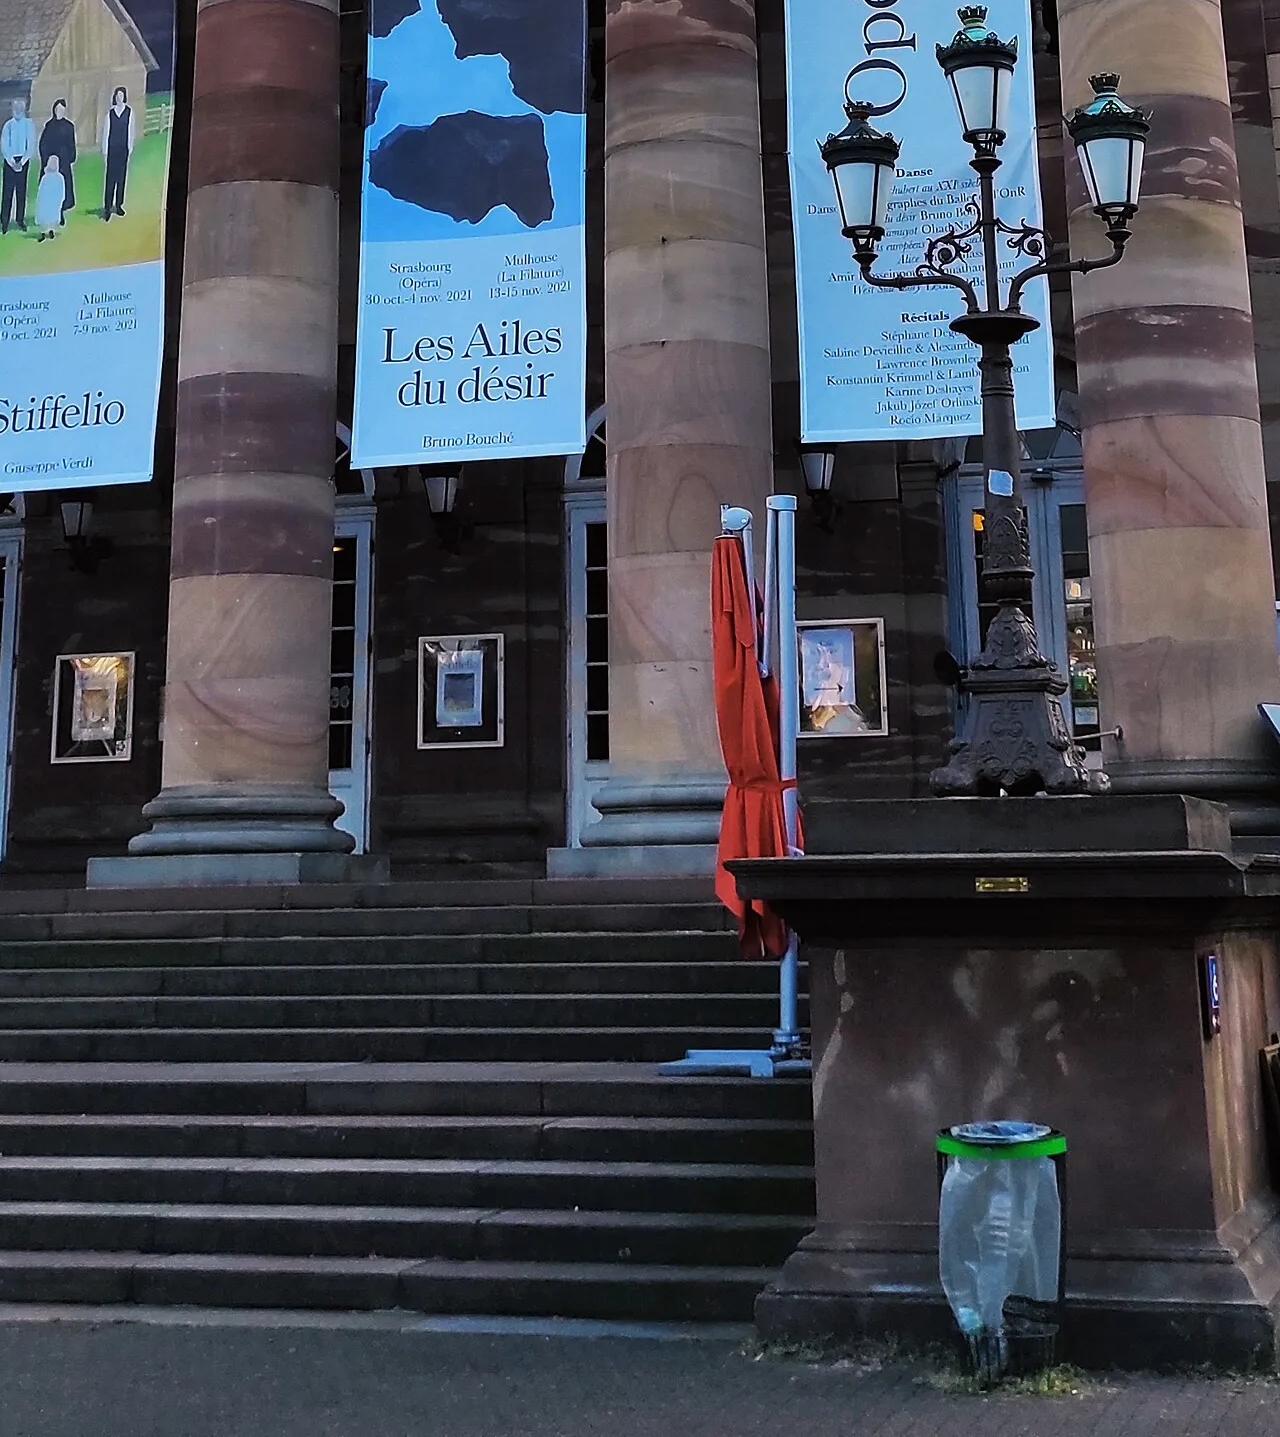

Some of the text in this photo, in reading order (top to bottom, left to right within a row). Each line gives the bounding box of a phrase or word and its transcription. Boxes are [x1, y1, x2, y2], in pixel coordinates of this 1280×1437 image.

[895, 167, 933, 178] Danse
[930, 195, 943, 206] du
[946, 192, 972, 204] Balle
[920, 209, 952, 221] Bruno
[886, 226, 918, 238] amuyot
[504, 252, 558, 267] Mulhouse
[898, 254, 920, 265] Alice
[389, 261, 452, 275] Strasbourg
[497, 266, 565, 284] (La Filature)
[828, 270, 855, 282] Amir
[944, 264, 985, 275] onathan
[398, 276, 442, 292] (Opéra)
[489, 280, 572, 300] 13-15 nov. 2021
[83, 291, 132, 306] Mulhouse
[365, 293, 380, 306] 30
[420, 292, 442, 304] nov.
[446, 289, 472, 302] 2021
[0, 314, 39, 329] (Opéra)
[76, 304, 137, 323] (La Filature)
[901, 311, 950, 324] Récitals
[11, 330, 30, 341] oct.
[33, 327, 57, 340] 2021
[73, 318, 138, 336] 7-9 nov. 2021
[881, 327, 930, 343] Stéphane
[381, 318, 563, 364] Les Ailes
[823, 347, 860, 359] Sabine
[915, 343, 924, 354] &
[877, 353, 980, 370] Lawrence Brownlee
[397, 362, 555, 407] du désir
[826, 373, 884, 386] Konstantin
[886, 369, 934, 383] Krimmel
[936, 370, 945, 380] &
[885, 383, 974, 397] Karine Deshayes
[875, 400, 908, 414] Jakub
[422, 431, 515, 449] Bruno Bouché
[4, 455, 94, 475] Giuseppe Verdi
